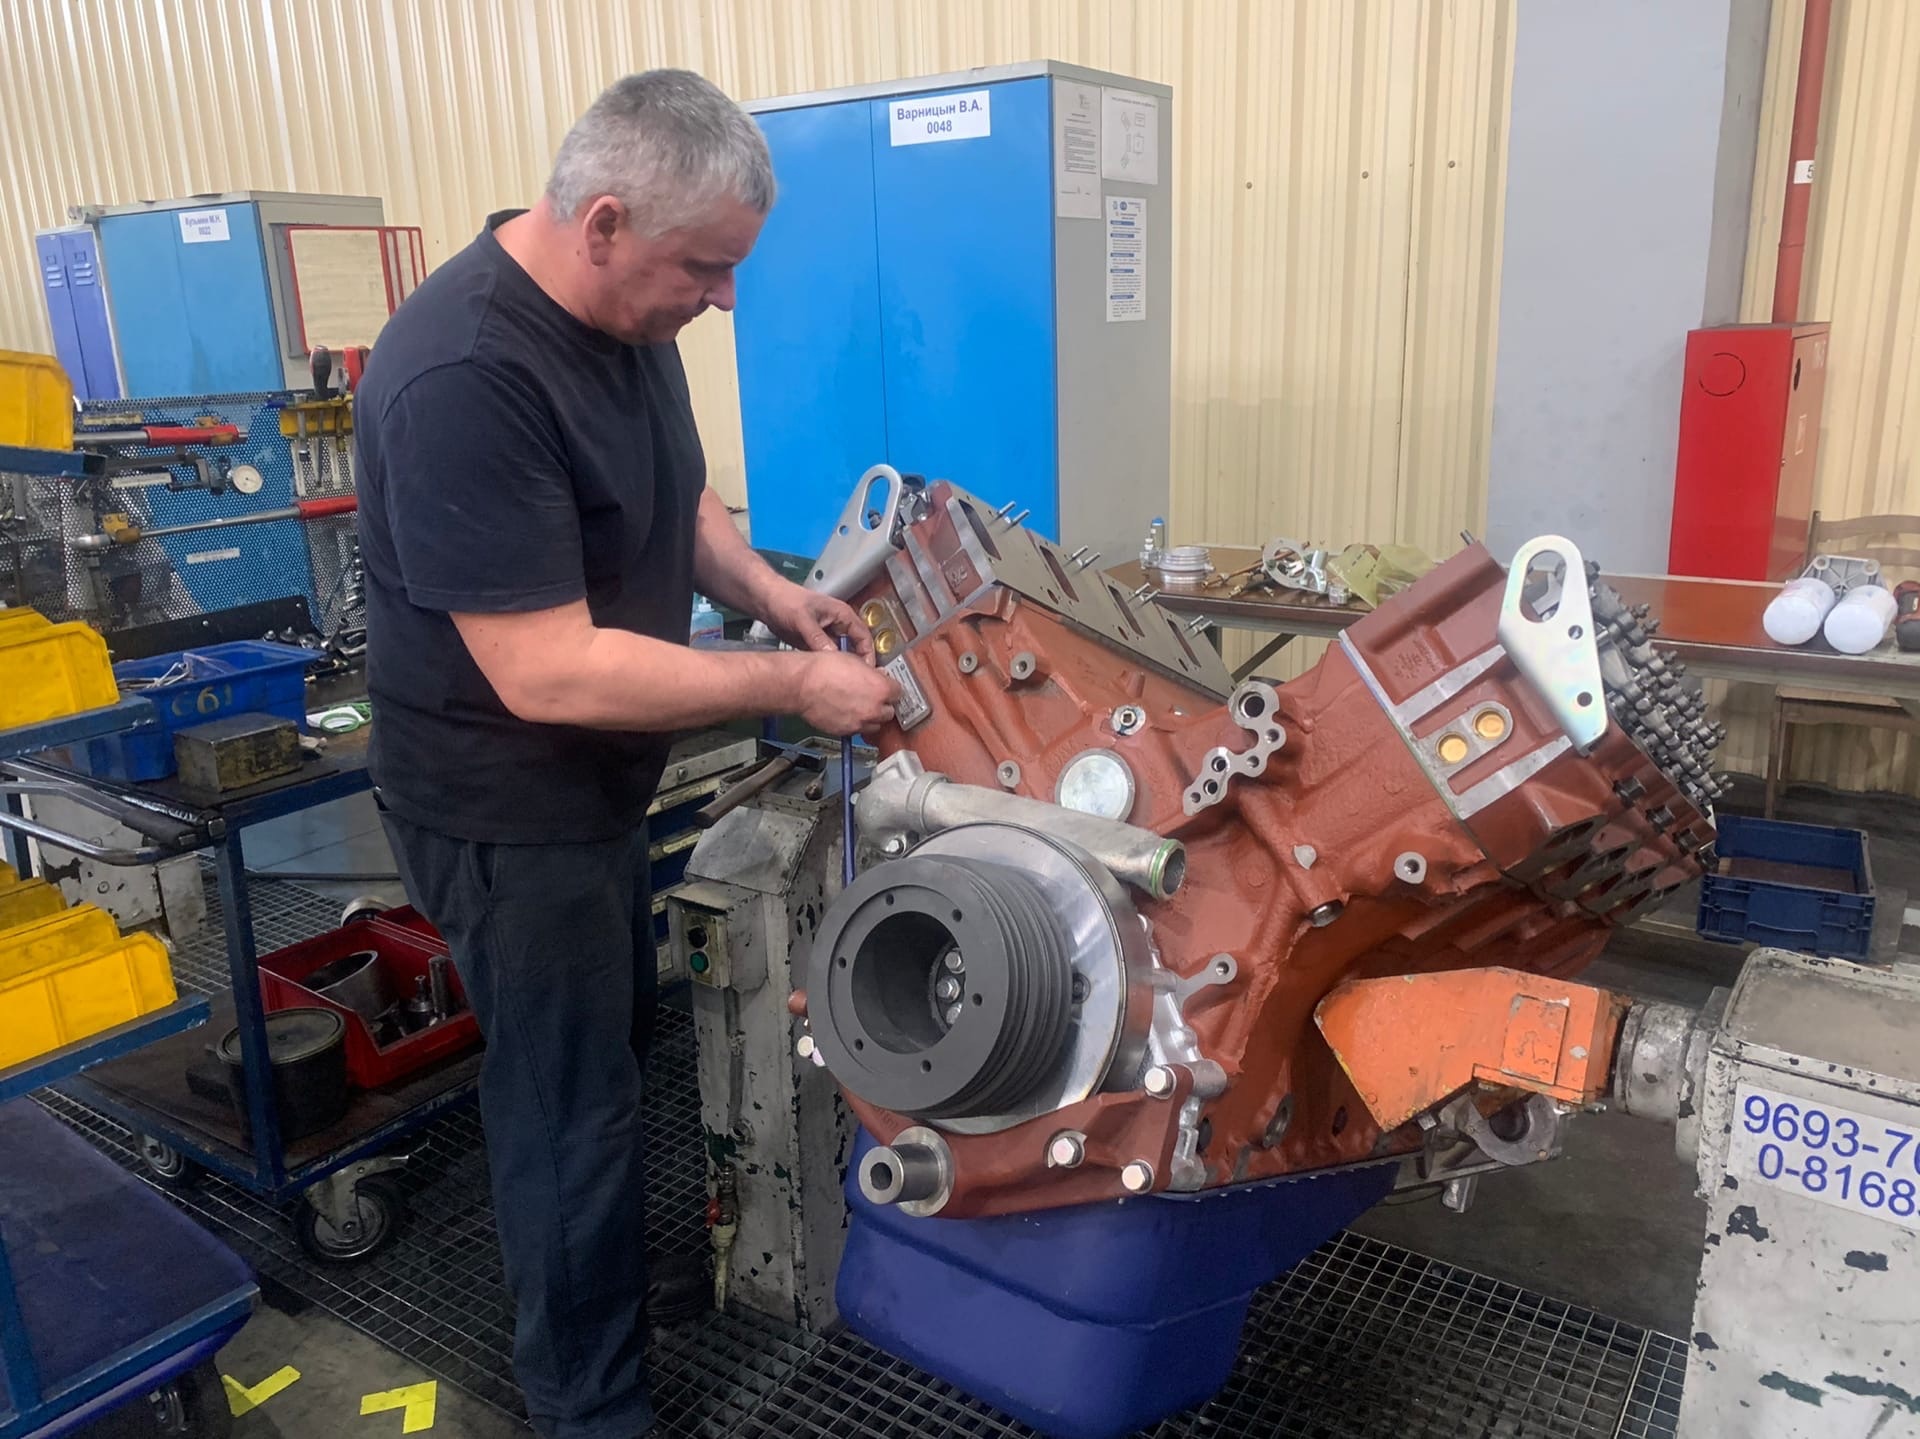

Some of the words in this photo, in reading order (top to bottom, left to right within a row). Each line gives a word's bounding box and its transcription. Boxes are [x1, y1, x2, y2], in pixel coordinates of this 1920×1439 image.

[897, 104, 956, 121] Варницын
[959, 99, 983, 113] В.А.
[927, 120, 953, 134] 0048
[1744, 1095, 1920, 1175] 9693-7
[1758, 1143, 1920, 1216] 0-8168
